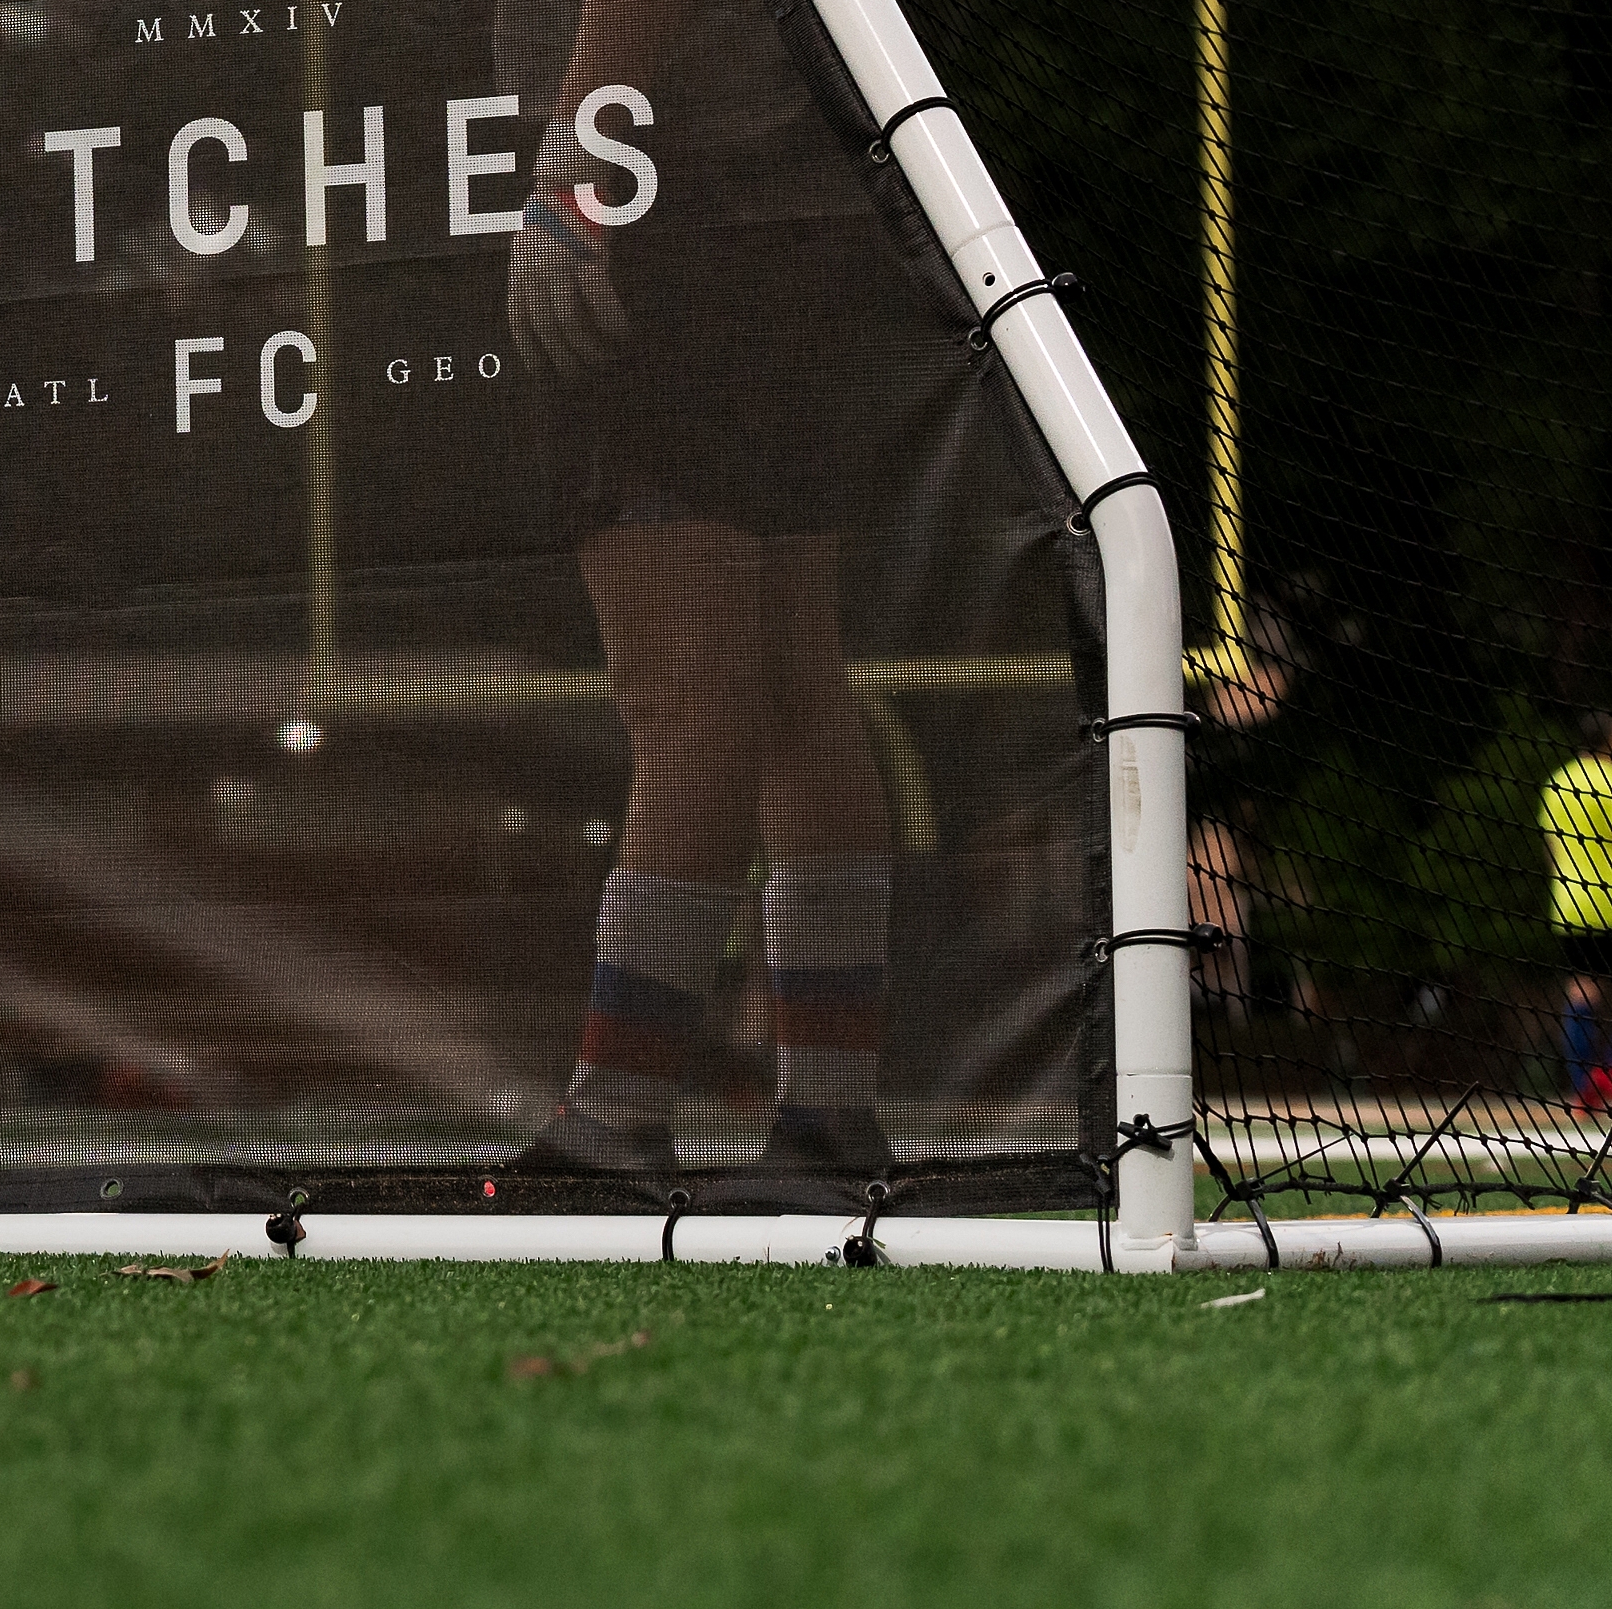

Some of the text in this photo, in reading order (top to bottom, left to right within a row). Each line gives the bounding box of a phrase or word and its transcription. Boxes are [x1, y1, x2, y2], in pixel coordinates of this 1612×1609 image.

[134, 1, 345, 43] MMXIV
[175, 329, 319, 433] FC
[386, 352, 503, 385] GEO
[3, 377, 110, 408] ATL
